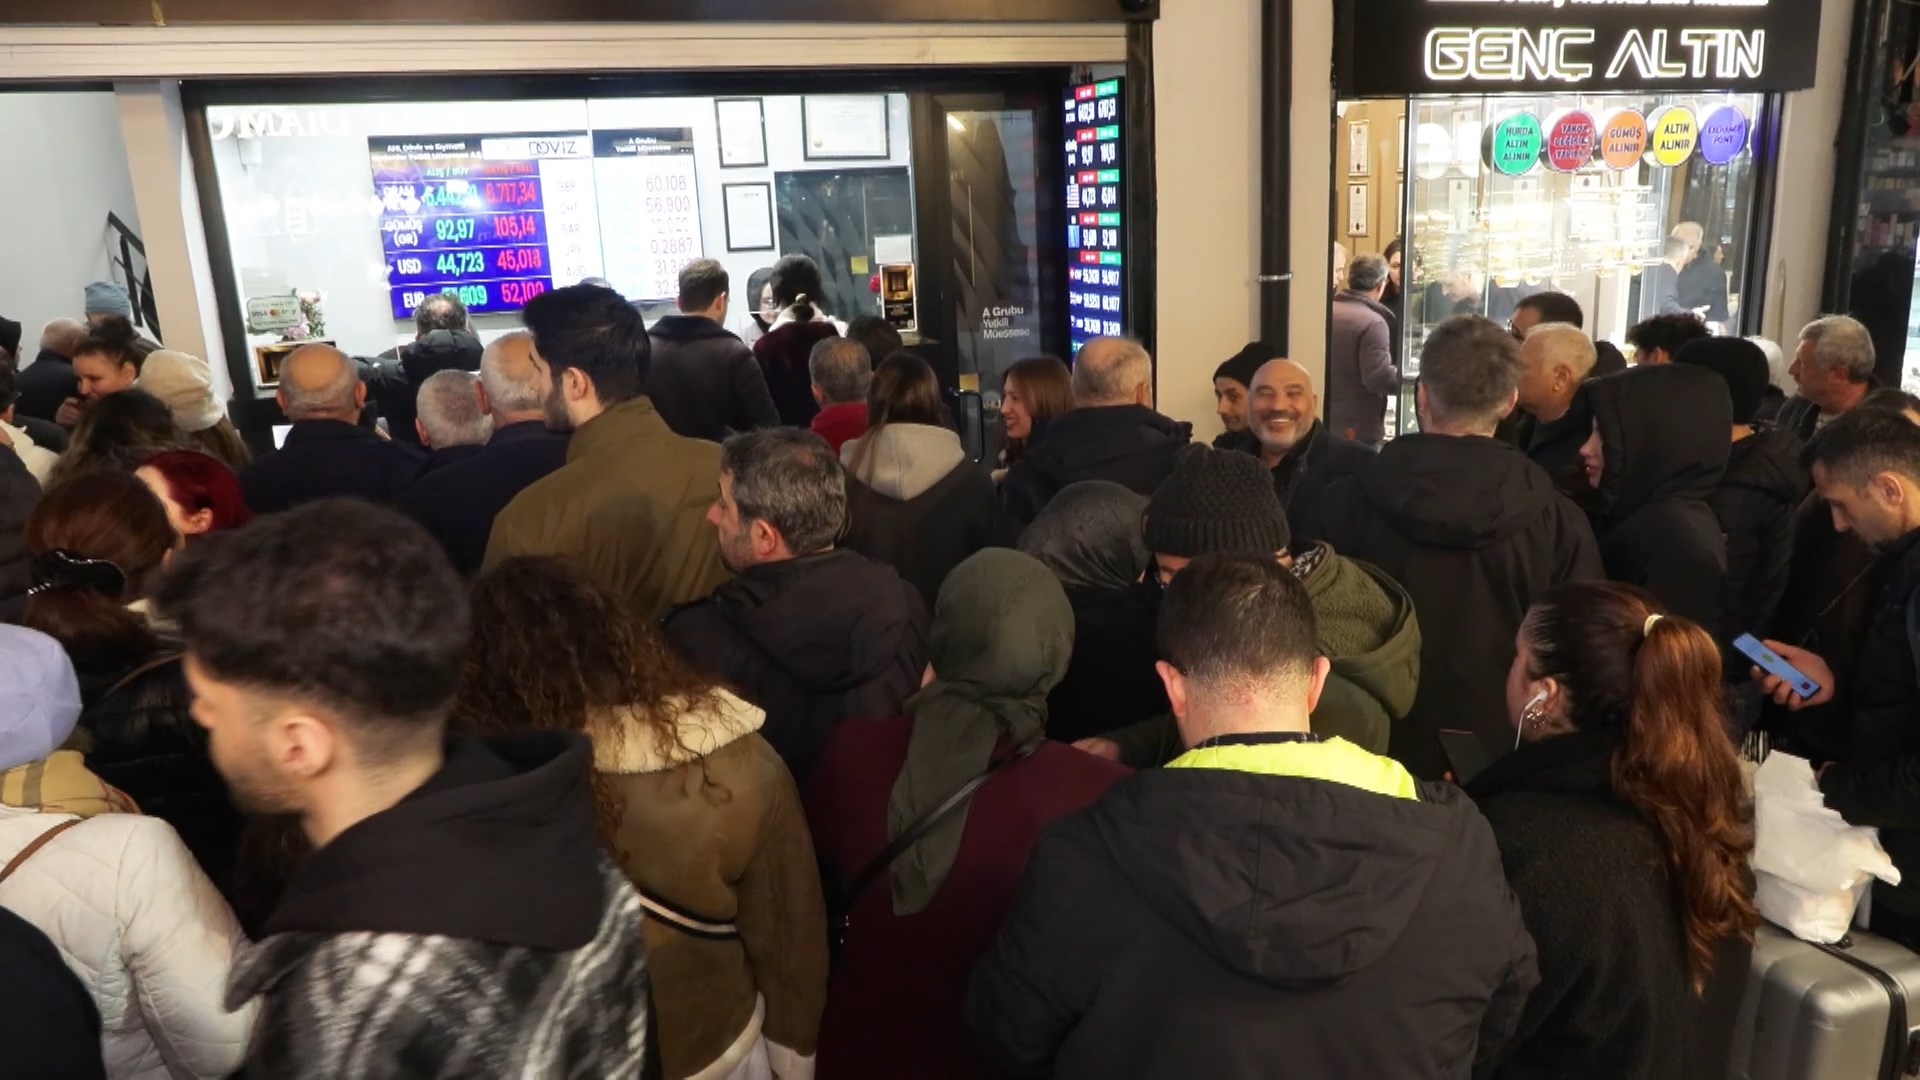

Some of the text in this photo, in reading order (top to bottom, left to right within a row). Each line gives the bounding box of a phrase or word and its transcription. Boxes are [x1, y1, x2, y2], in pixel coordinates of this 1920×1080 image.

[1424, 28, 1765, 82] GENÇ ALTIN
[1610, 127, 1642, 139] GÜMÜŞ
[1664, 123, 1690, 134] ALTIN
[1505, 140, 1528, 148] ALTIN
[1609, 144, 1639, 153] ALINIR
[1660, 139, 1690, 150] ALINIR
[435, 215, 536, 242] 92,97 105,14
[650, 236, 693, 257] 0,2887
[397, 258, 422, 275] USD
[436, 252, 485, 276] 44,723
[982, 305, 1024, 318] A Grubu
